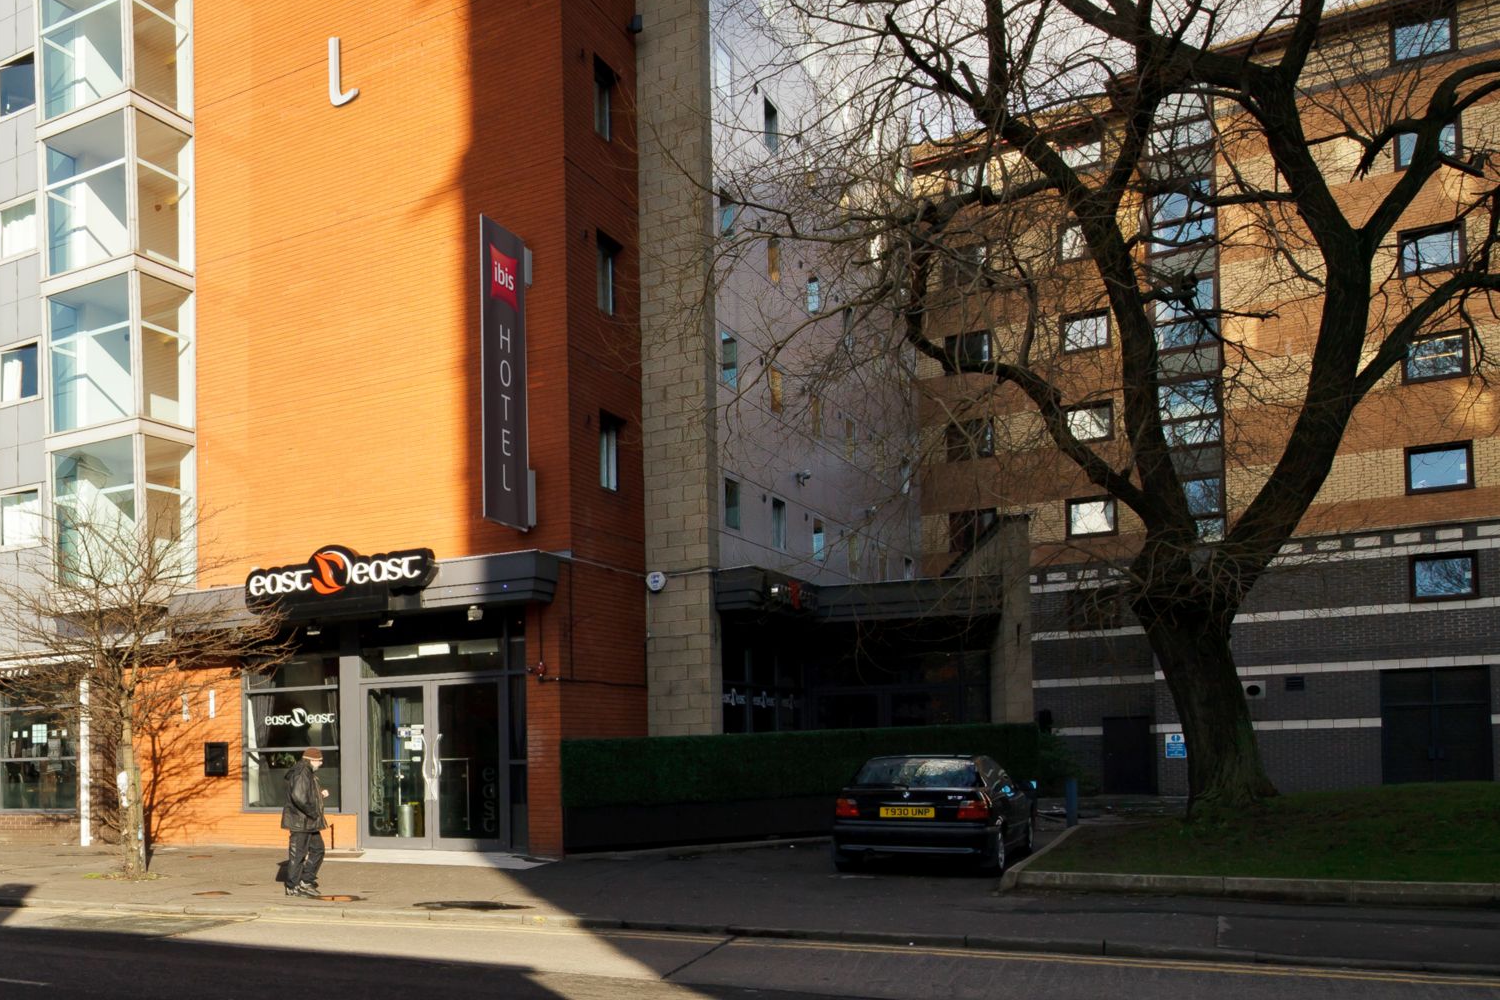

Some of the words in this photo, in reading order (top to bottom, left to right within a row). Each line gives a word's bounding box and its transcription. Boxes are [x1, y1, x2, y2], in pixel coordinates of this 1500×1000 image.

[494, 260, 514, 291] ibis
[499, 324, 512, 492] HOTEL
[250, 568, 314, 597] east
[351, 555, 422, 585] east
[264, 715, 291, 726] east
[307, 713, 335, 724] east
[884, 807, 909, 816] T930
[911, 807, 930, 816] UNP
